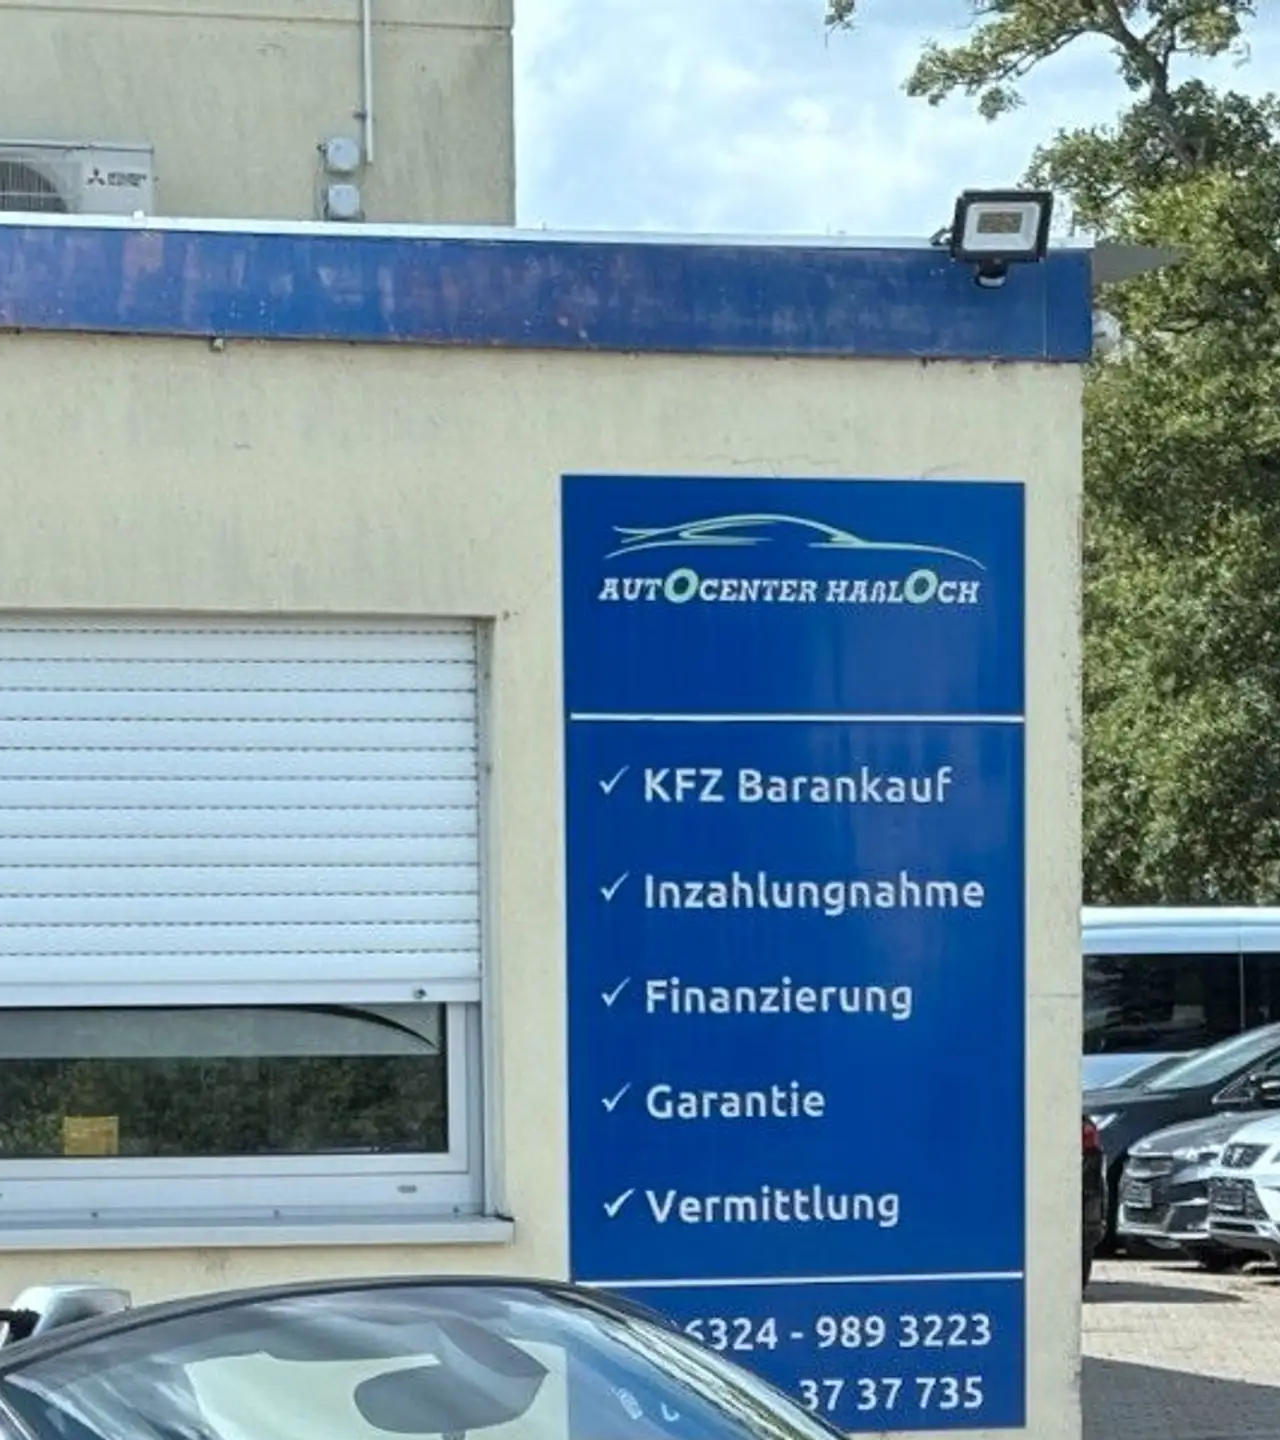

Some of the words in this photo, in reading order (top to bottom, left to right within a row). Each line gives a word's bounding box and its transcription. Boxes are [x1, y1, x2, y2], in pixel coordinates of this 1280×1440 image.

[598, 568, 818, 604] AUTOCENTER
[644, 768, 724, 802] KFZ
[738, 766, 953, 803] Barankauf
[645, 871, 985, 916] Inzahlungnahme
[646, 976, 913, 1021] Finanzierung
[646, 1081, 826, 1119] Garantie
[647, 1185, 900, 1227] Vermittlung
[816, 1315, 886, 1348] 989
[899, 1312, 992, 1347] 3223
[799, 1379, 845, 1412] 37
[857, 1377, 902, 1410] 37
[915, 1375, 984, 1409] 735
